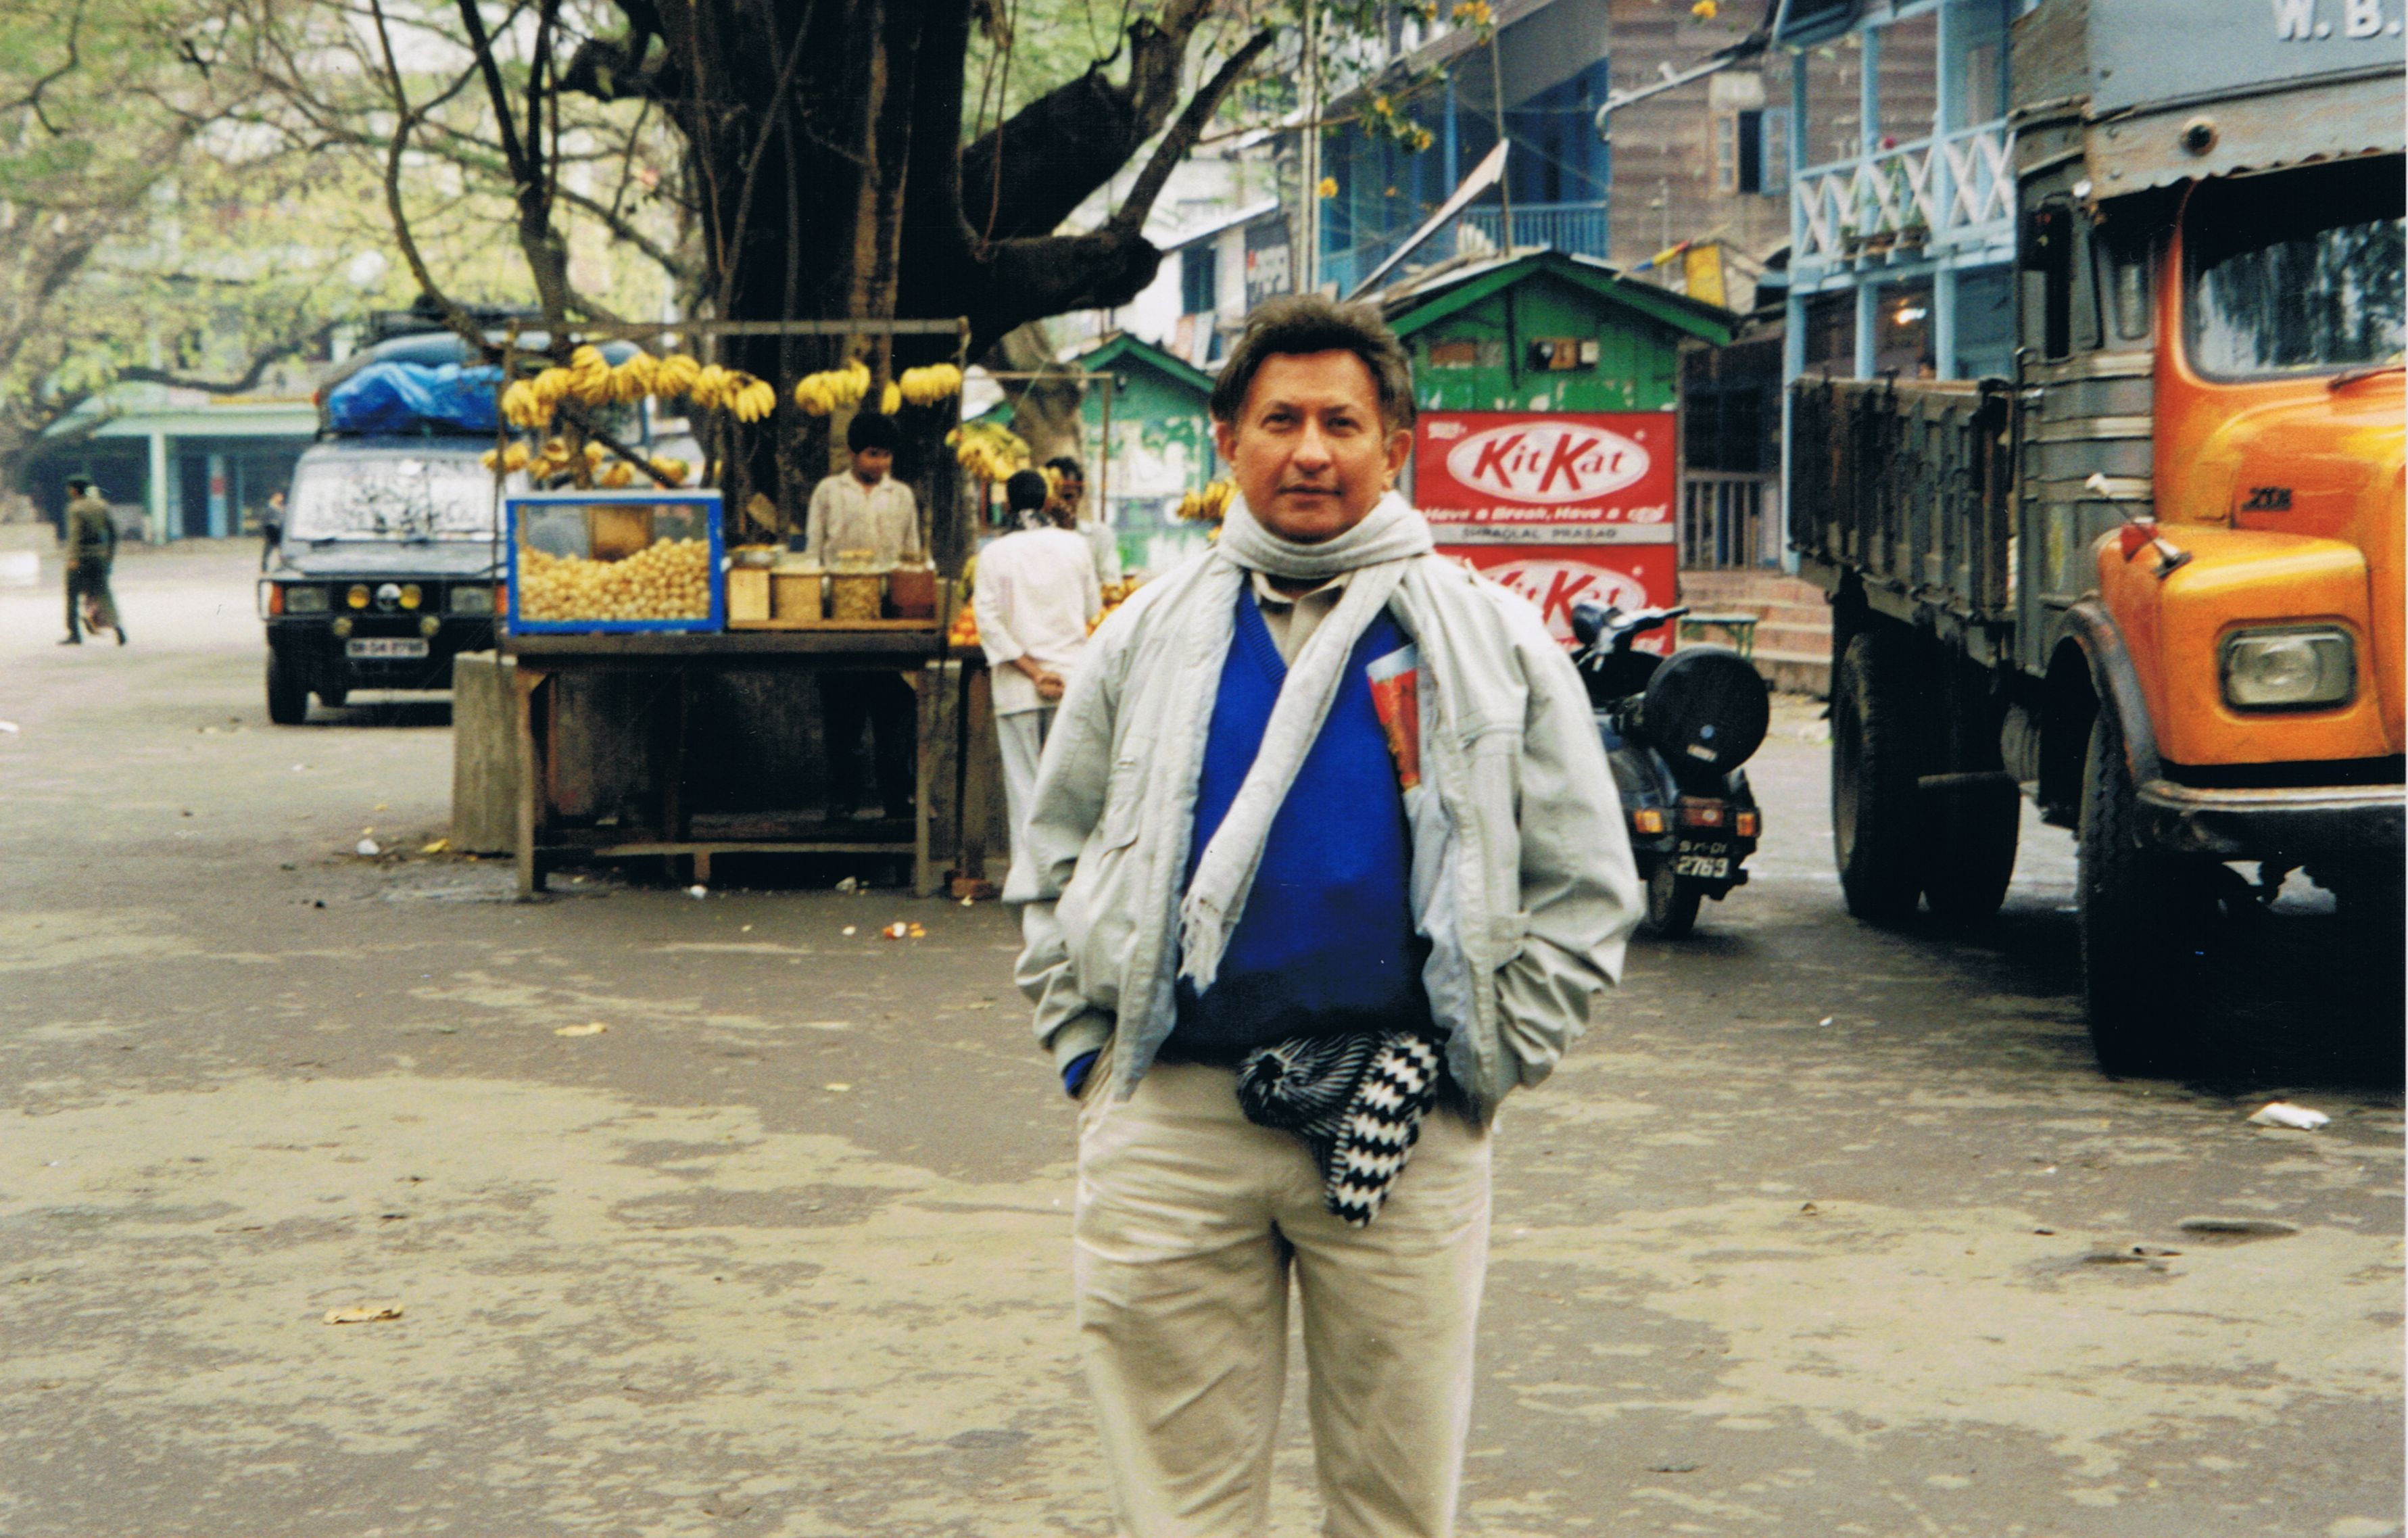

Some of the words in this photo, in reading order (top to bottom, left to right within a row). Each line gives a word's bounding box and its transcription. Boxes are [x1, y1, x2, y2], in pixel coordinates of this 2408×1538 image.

[1474, 508, 1488, 521] a
[1554, 506, 1604, 520] Have
[1606, 508, 1620, 520] a
